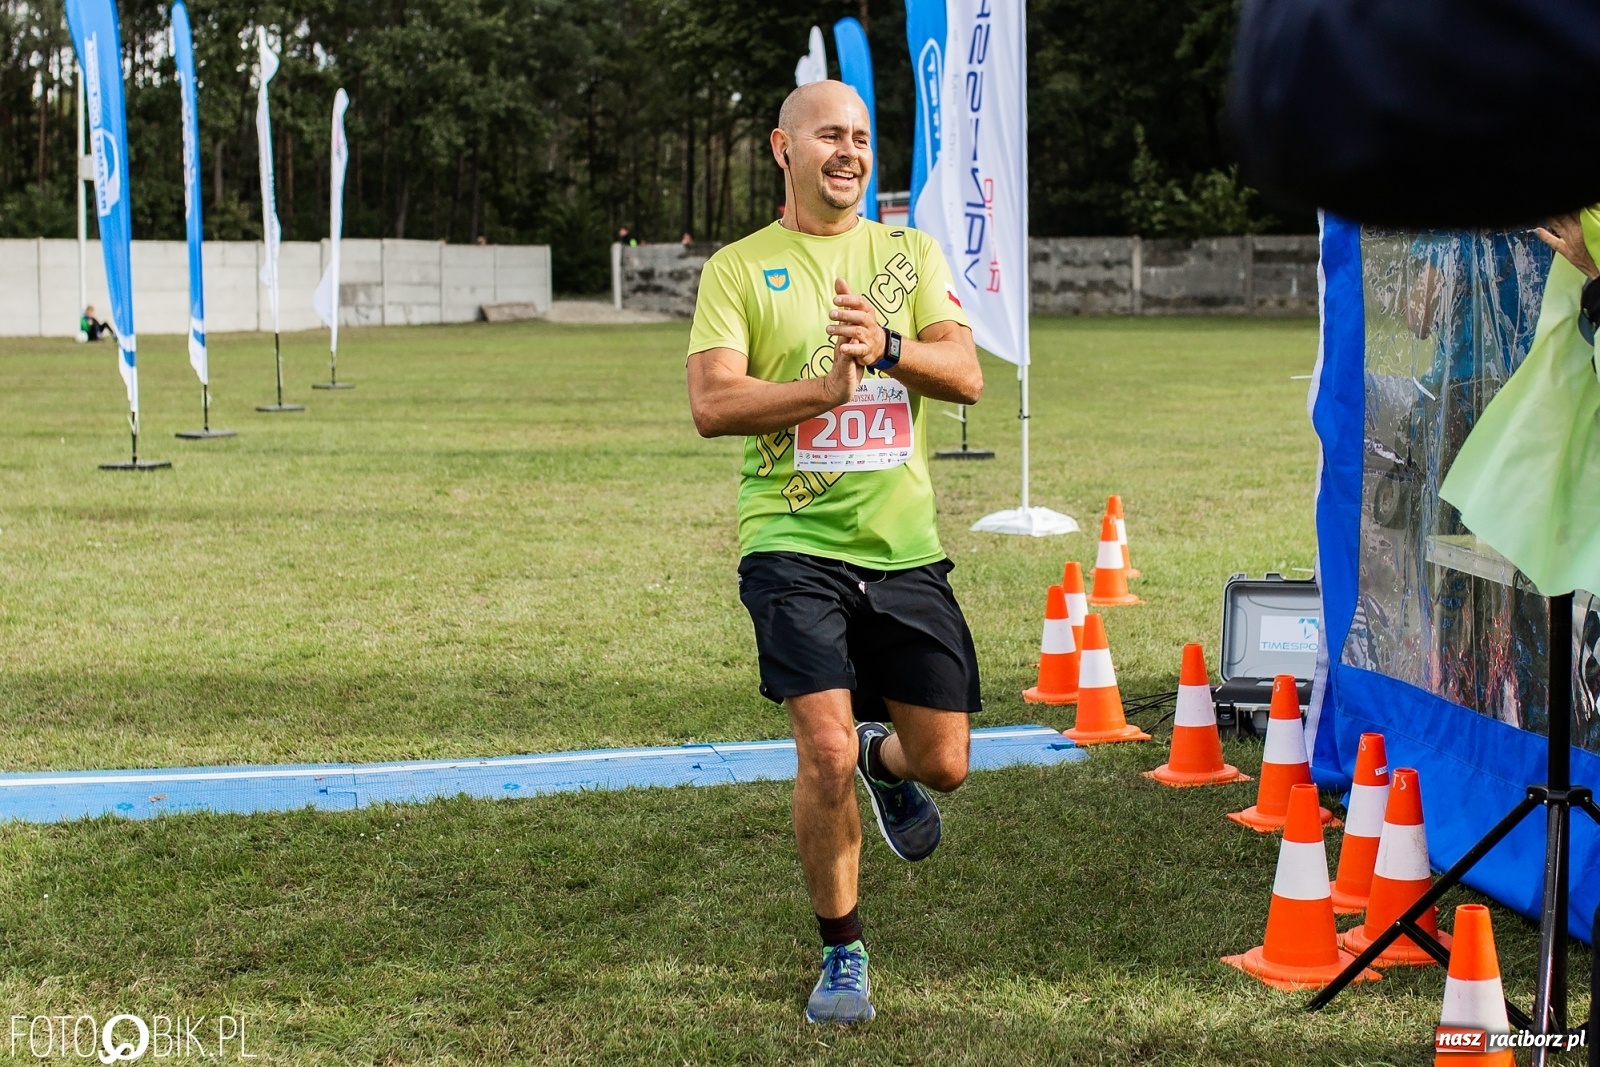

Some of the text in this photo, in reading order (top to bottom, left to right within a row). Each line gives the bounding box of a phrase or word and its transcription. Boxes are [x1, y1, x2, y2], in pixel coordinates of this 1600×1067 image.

[855, 384, 868, 392] SKA
[811, 408, 896, 448] 204
[1392, 773, 1407, 791] TS
